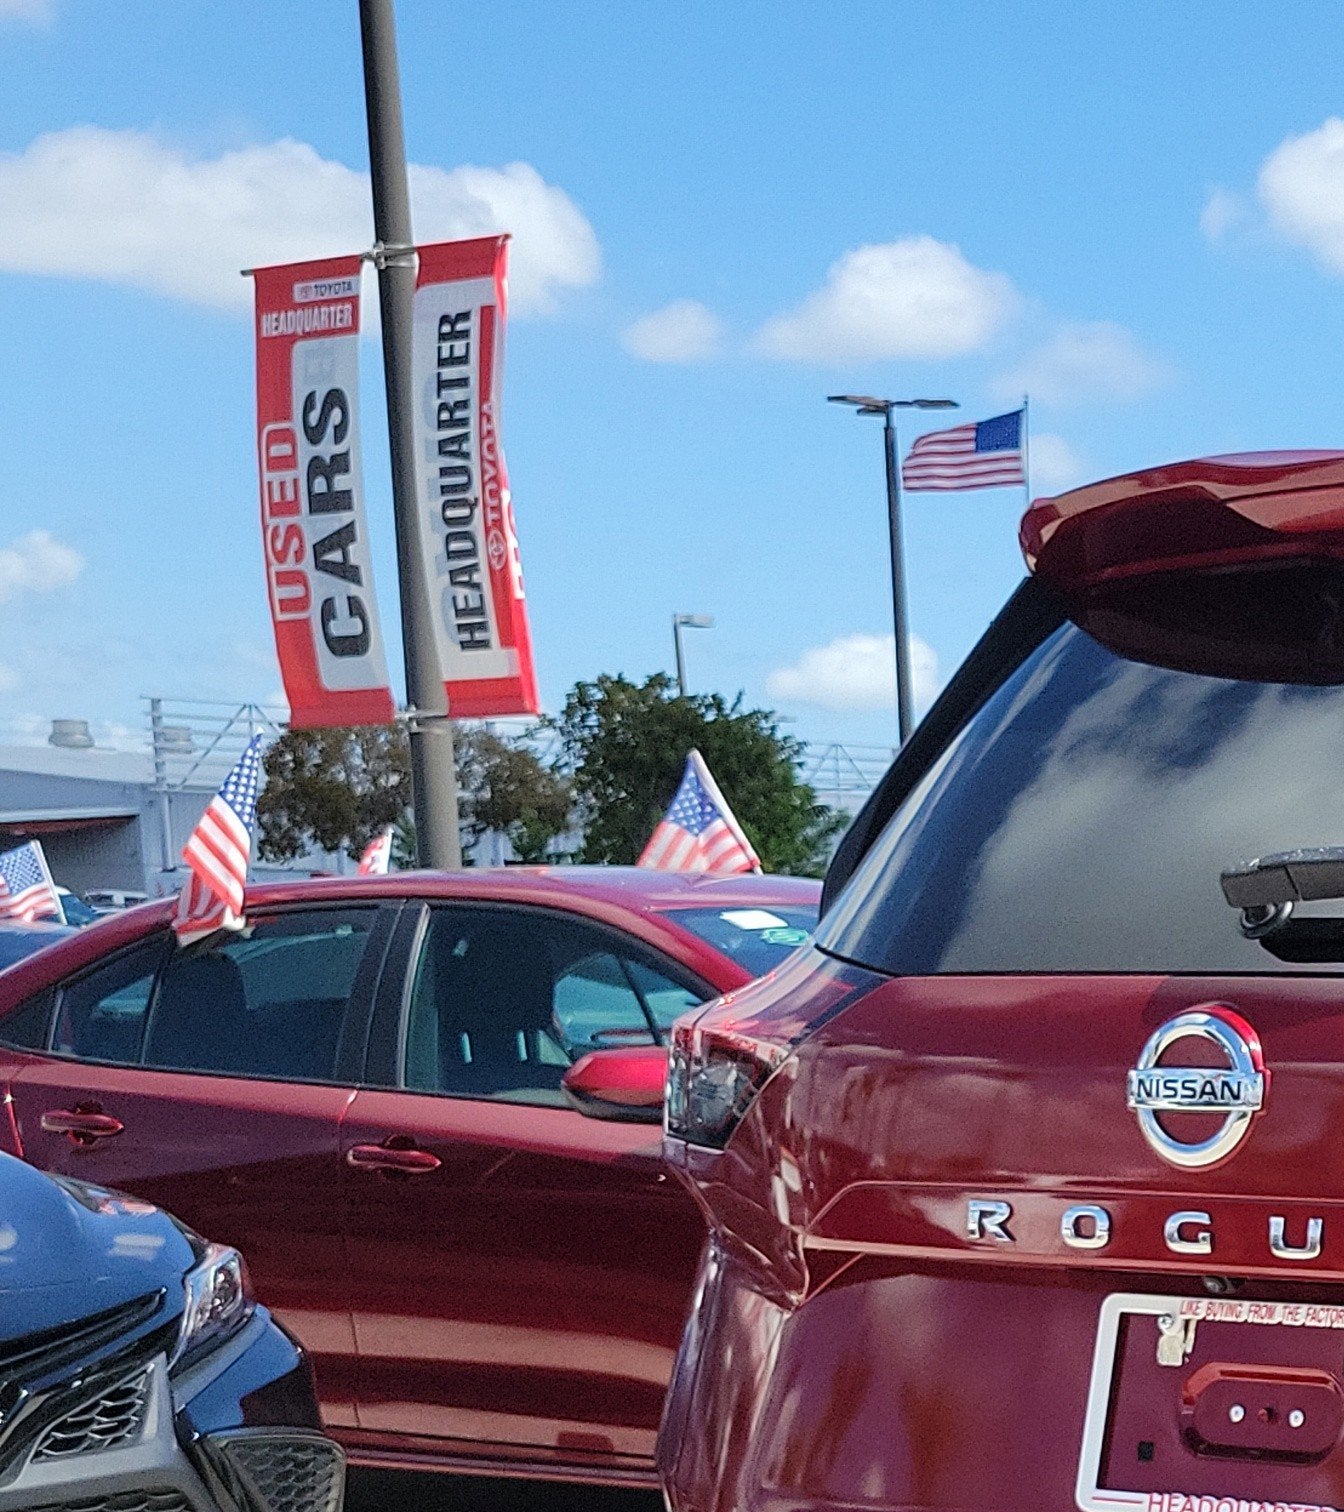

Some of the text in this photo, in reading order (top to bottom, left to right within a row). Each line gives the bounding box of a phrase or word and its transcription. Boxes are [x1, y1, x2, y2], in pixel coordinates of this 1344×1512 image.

[314, 281, 353, 297] TOYOTA
[262, 302, 353, 337] HEADQUARTER
[437, 308, 492, 651] HEADQUARTER
[263, 423, 312, 621] USED
[303, 388, 371, 658] CARS
[1136, 1075, 1243, 1103] NISSAN
[1180, 1301, 1201, 1316] LIKE
[1205, 1302, 1243, 1319] BUYING
[1249, 1304, 1277, 1320] FROM
[1282, 1306, 1300, 1322] THE
